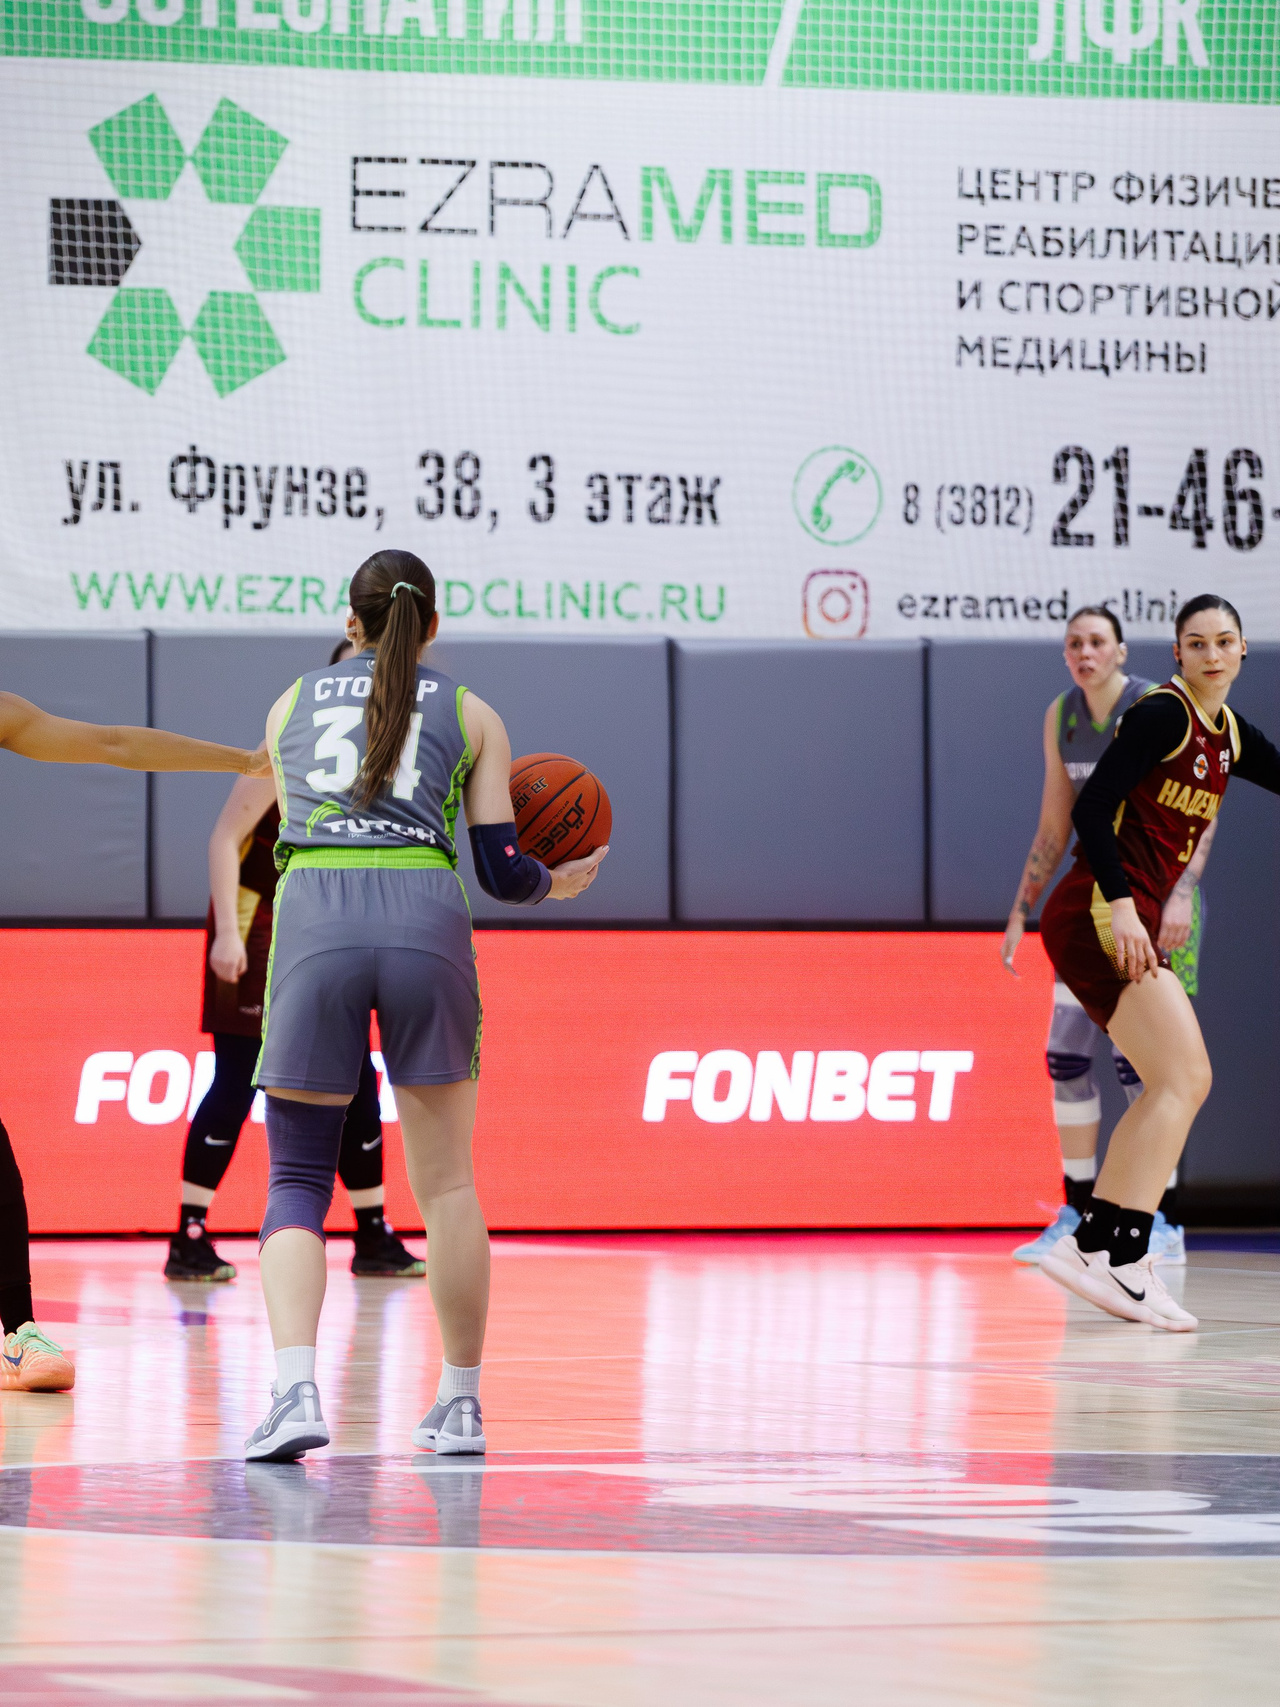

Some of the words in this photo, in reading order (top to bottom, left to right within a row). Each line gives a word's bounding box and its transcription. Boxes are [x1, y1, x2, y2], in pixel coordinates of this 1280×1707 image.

[351, 156, 884, 249] EZRAMED
[957, 166, 1096, 206] ЦЕНТР
[1111, 170, 1280, 209] ФИЗИЧЕ
[956, 223, 1280, 269] РЕАБИЛИТАЦИ
[353, 257, 642, 335] CLINIC
[957, 281, 982, 311] И
[954, 336, 1209, 377] МЕДИЦИНЫ
[61, 458, 140, 527] ул.
[168, 444, 386, 532] Фрунзе,
[417, 449, 499, 534] 38,
[528, 453, 556, 524] 3
[584, 472, 723, 526] этаж
[901, 483, 920, 526] 8
[934, 483, 1034, 535] (3812)
[70, 571, 726, 624] WWW.EZRADCLINIC.RU
[314, 675, 439, 702] СТОР
[642, 1049, 975, 1124] FONBET
